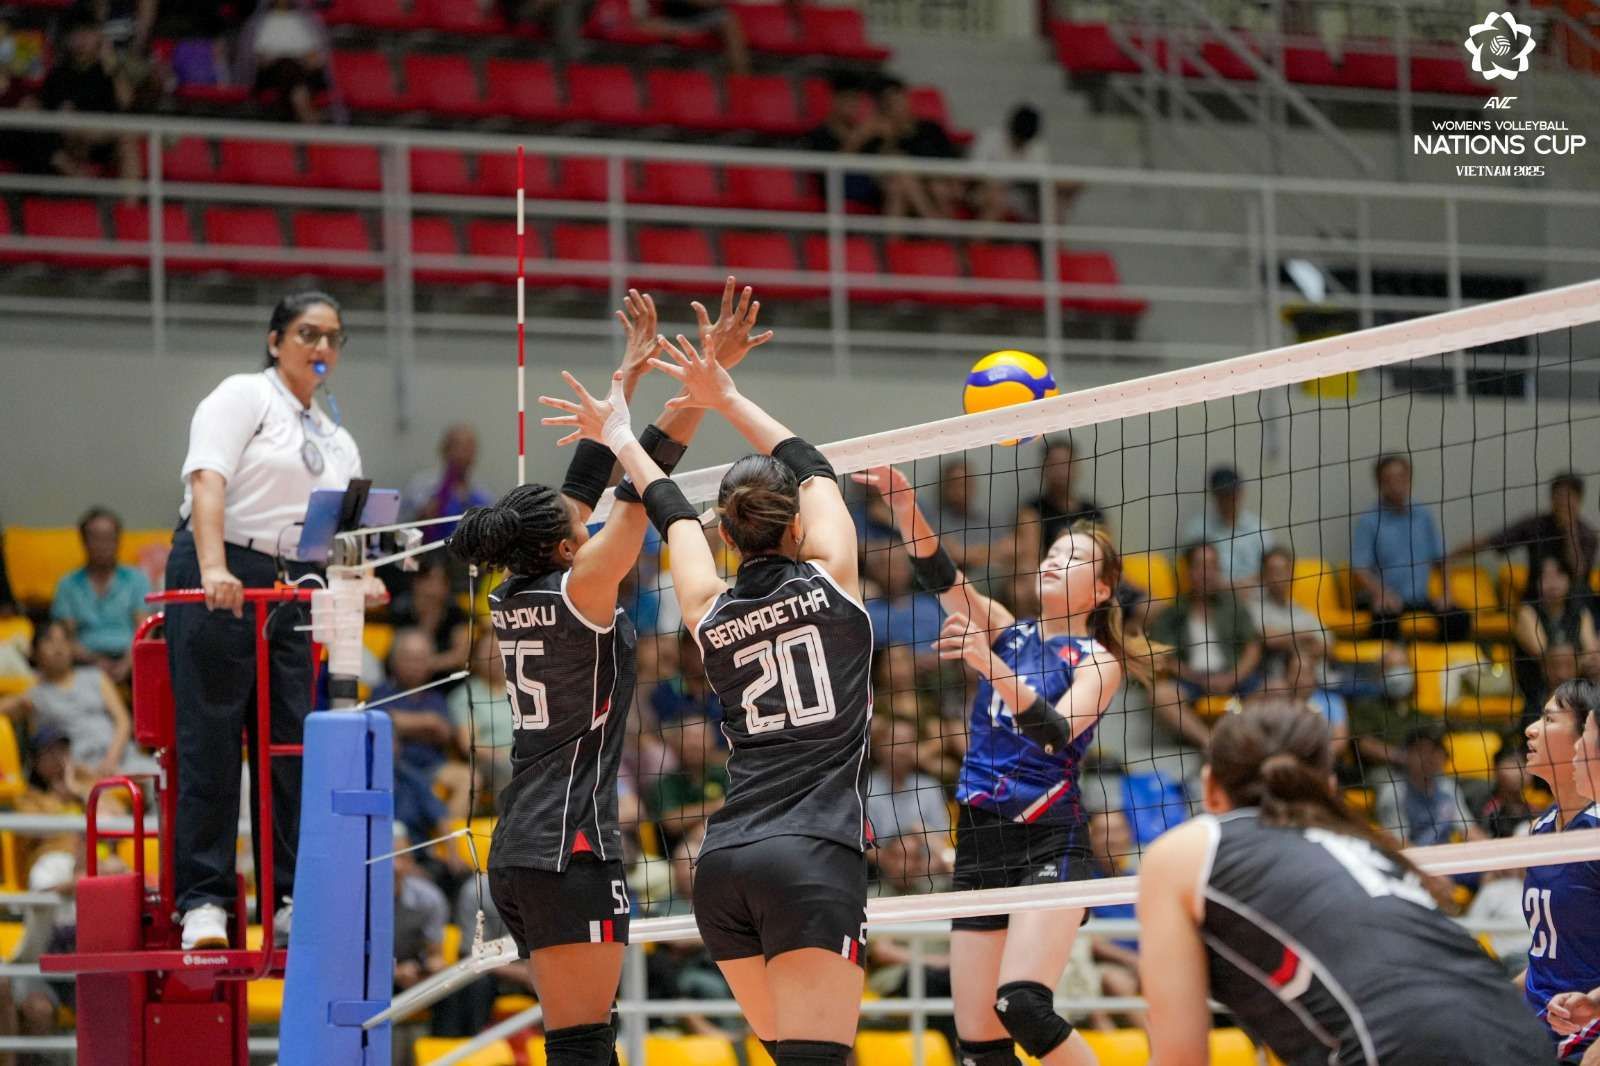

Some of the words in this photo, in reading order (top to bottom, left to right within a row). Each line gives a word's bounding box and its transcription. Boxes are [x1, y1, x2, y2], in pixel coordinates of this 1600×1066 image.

[704, 587, 831, 650] BERNADETHA
[733, 624, 837, 735] 20
[1525, 887, 1558, 960] 21
